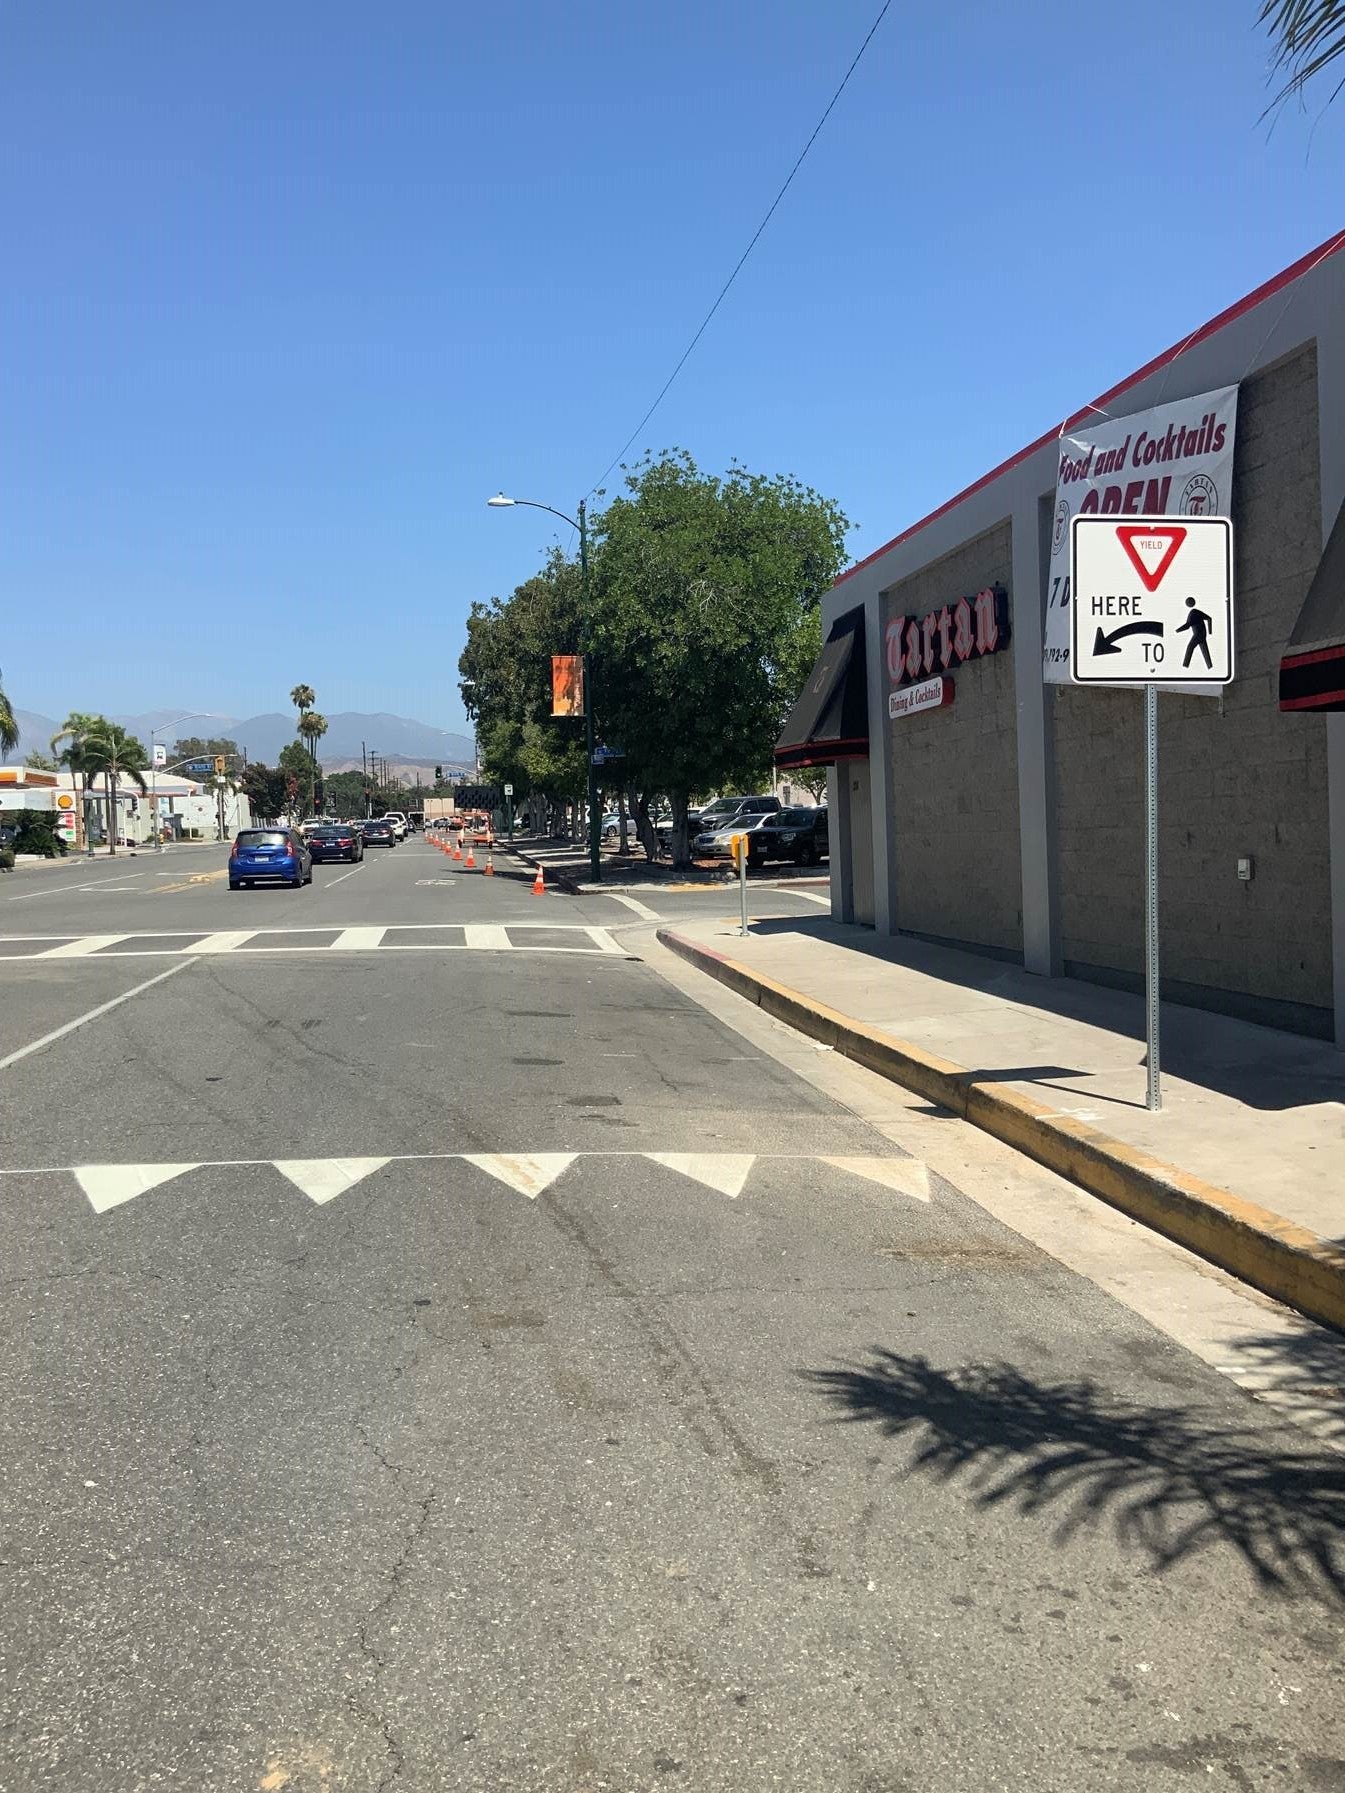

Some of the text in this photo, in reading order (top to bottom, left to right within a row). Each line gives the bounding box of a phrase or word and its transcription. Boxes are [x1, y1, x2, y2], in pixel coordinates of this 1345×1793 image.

[1058, 412, 1227, 487] Food and Cocktails
[1079, 475, 1173, 515] OPEN
[1140, 540, 1163, 550] YIELD
[1091, 596, 1142, 616] HERE
[885, 588, 998, 685] Tartan
[1142, 643, 1164, 663] TO
[891, 683, 941, 712] Dining & Cocktails
